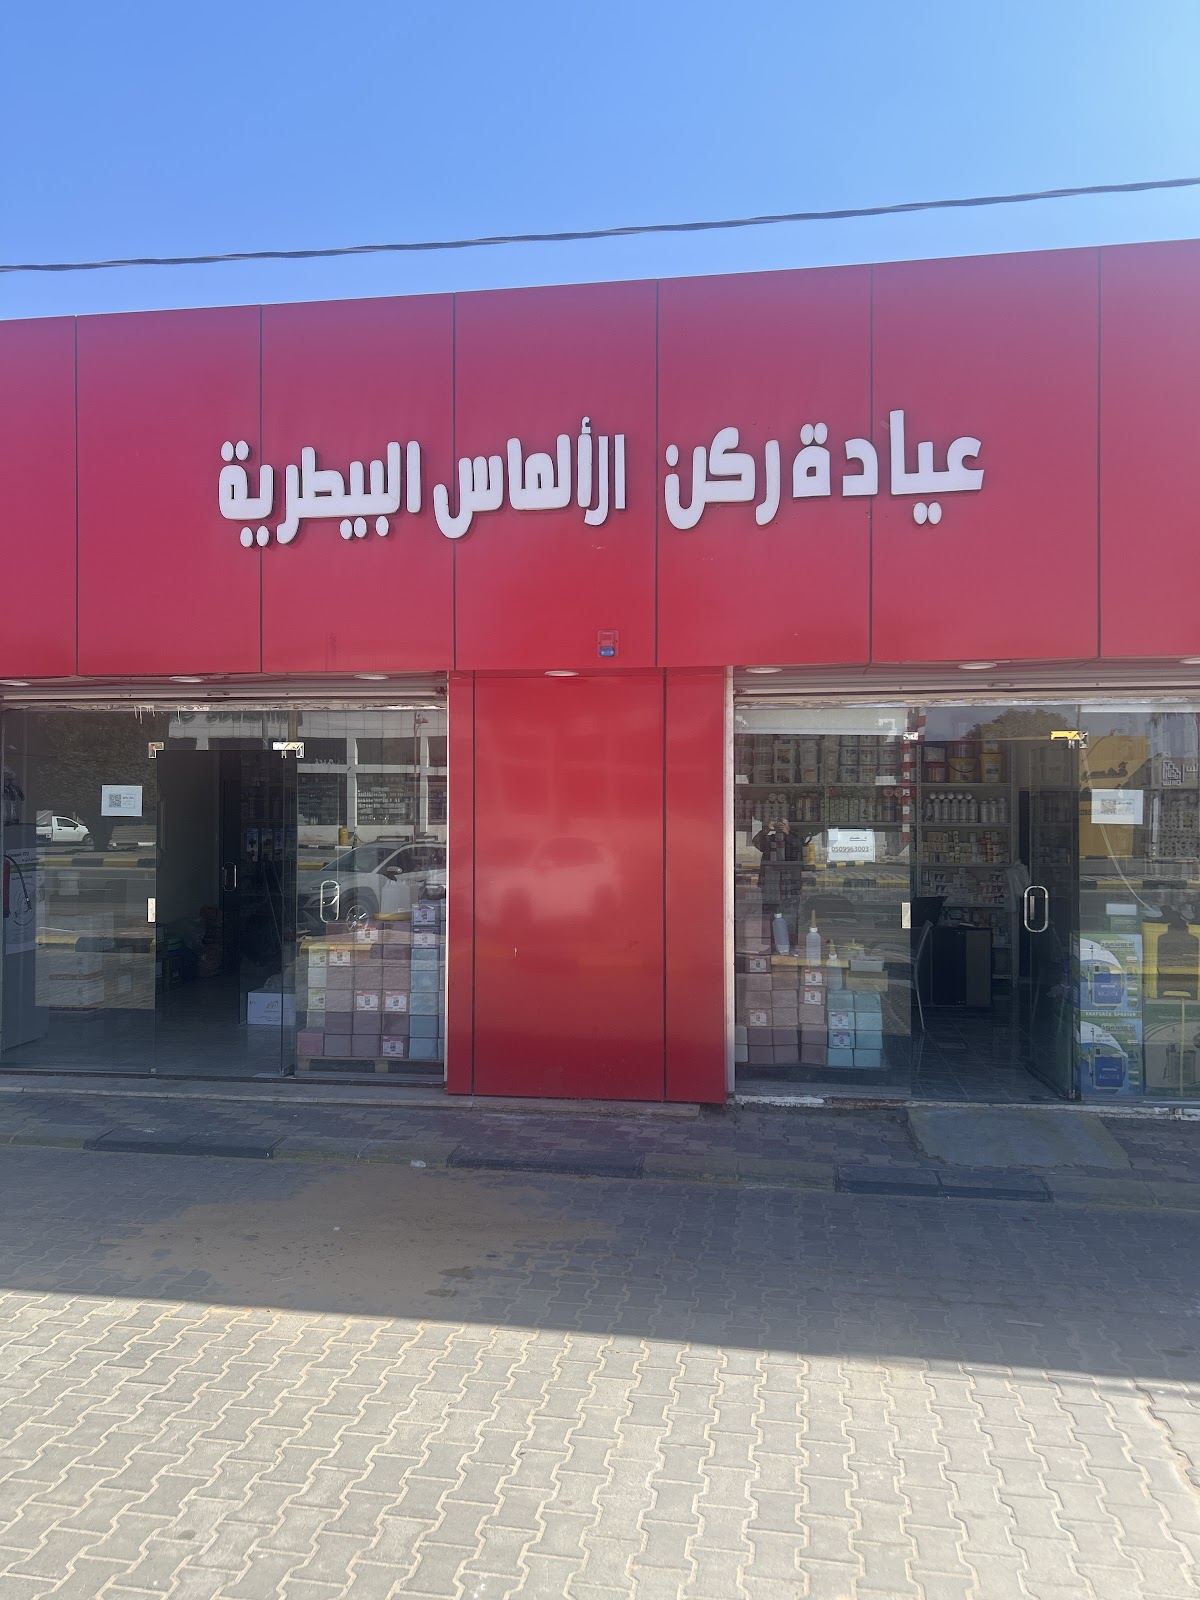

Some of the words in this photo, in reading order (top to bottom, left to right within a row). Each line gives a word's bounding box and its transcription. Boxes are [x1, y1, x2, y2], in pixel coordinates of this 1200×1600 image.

[218, 440, 421, 548] البيطرية
[664, 426, 780, 530] ركن
[792, 409, 985, 525] عيادة
